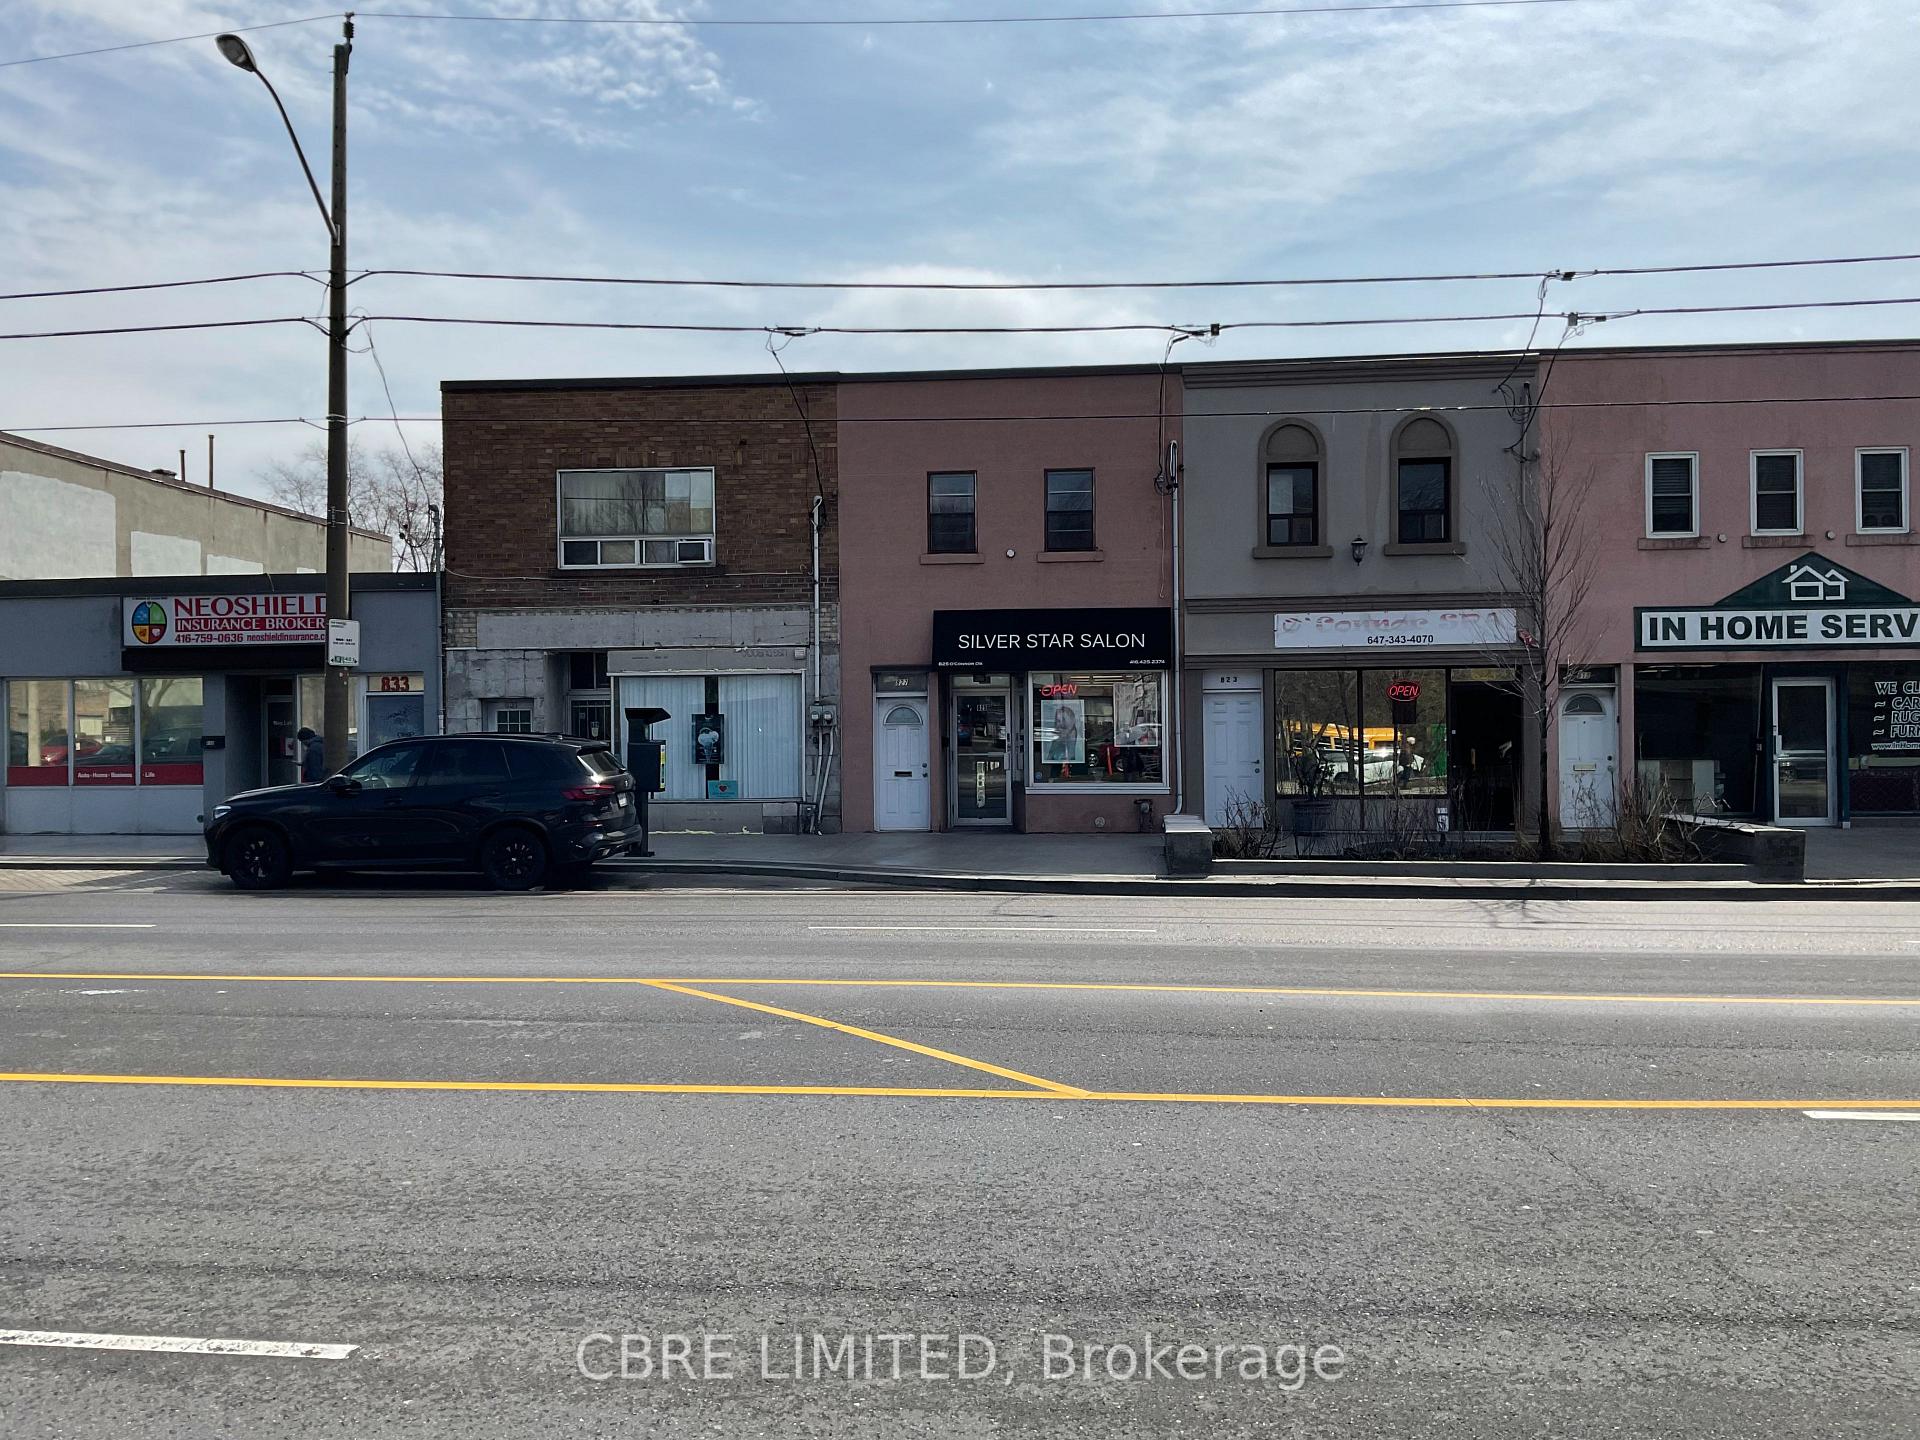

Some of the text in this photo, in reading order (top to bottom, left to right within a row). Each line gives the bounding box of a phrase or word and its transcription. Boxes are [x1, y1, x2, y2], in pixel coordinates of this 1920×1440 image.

[177, 618, 261, 631] INSURANCE
[1649, 613, 1919, 641] IN HOME SERV
[175, 633, 243, 643] 416-759-0636
[958, 633, 1146, 649] SILVER STAR SALON
[1367, 635, 1434, 645] 647-343-4070
[381, 676, 410, 692] 833
[1041, 684, 1077, 697] OPEN
[1874, 681, 1898, 695] WE
[1389, 685, 1419, 697] OPEN
[1871, 741, 1920, 750] www.InHom
